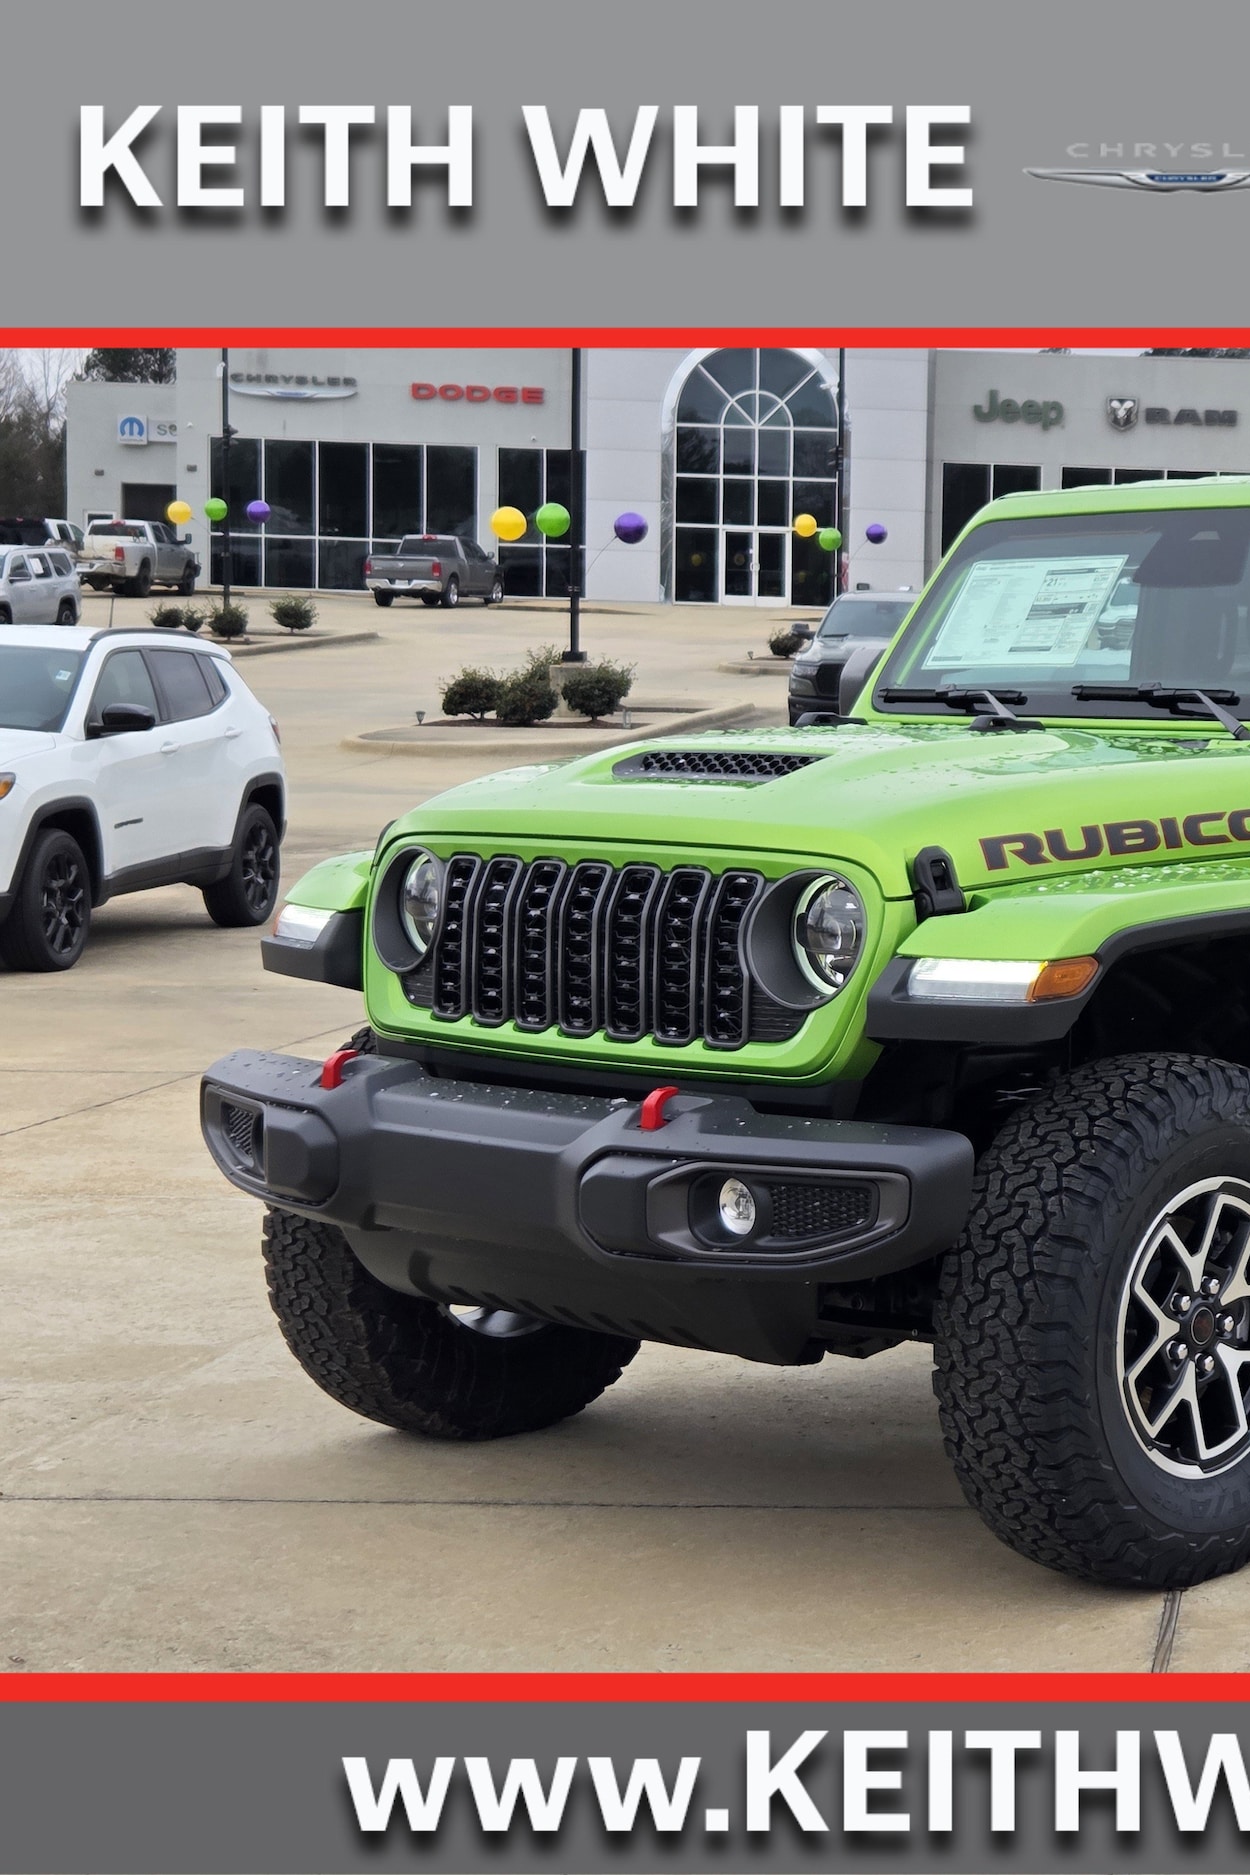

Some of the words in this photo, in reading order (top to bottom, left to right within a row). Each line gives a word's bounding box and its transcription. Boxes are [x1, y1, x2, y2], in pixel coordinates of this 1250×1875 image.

[230, 372, 358, 387] CHRYSLER
[411, 382, 545, 405] DODGE
[973, 389, 1064, 431] Jeep
[1145, 407, 1238, 428] RAM
